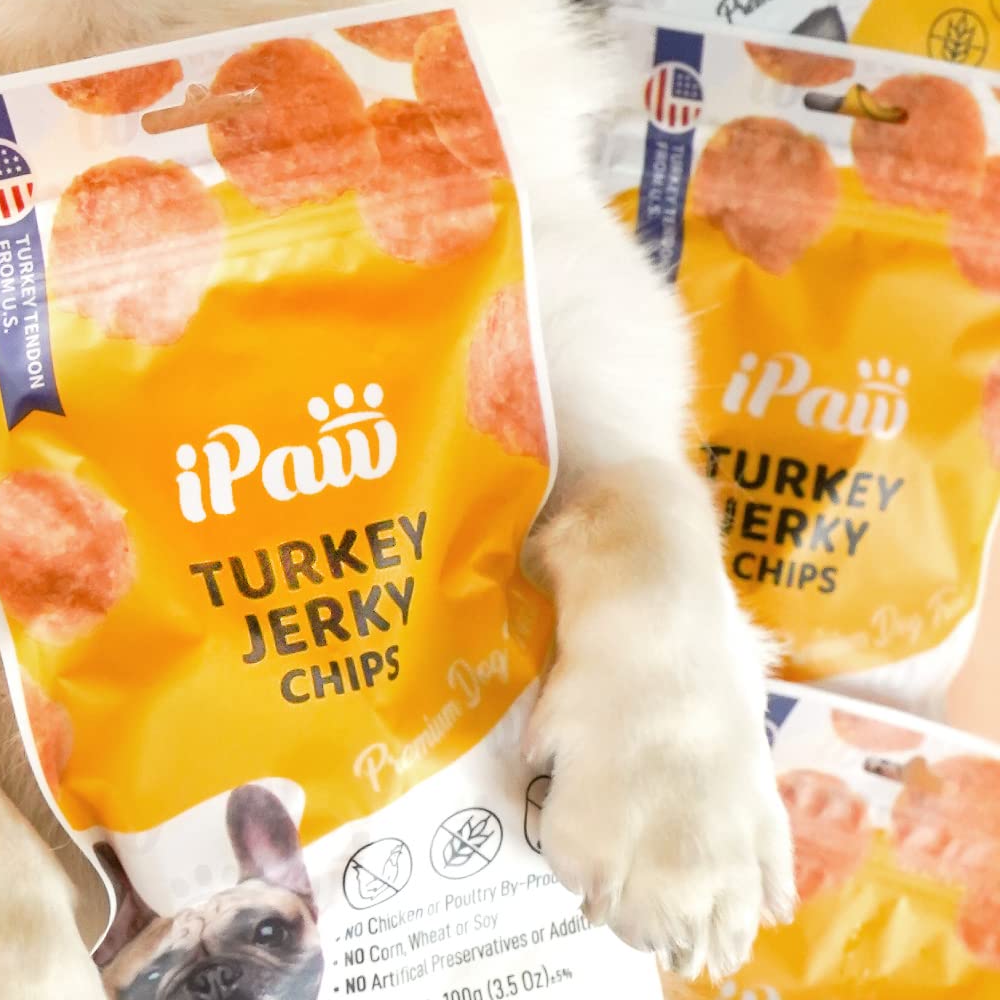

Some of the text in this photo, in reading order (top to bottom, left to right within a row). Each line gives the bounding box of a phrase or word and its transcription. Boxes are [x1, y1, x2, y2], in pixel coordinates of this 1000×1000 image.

[2, 299, 19, 334] U.S.
[15, 233, 45, 390] TURKEY TENDON
[721, 351, 910, 441] iPaw
[176, 383, 398, 523] iPaw
[701, 445, 905, 512] TURKEY
[189, 511, 428, 608] TURKEY
[732, 552, 838, 594] CHIPS
[242, 576, 416, 665] JERKY
[280, 645, 400, 705] CHIPS
[353, 647, 511, 793] Premium Dog
[345, 874, 559, 941] NO Chicken or Poultry By-Pro
[345, 913, 498, 967] NO Corn, Wheat or Soy
[346, 975, 366, 995] NO
[431, 932, 528, 973] Preservatives
[531, 927, 545, 945] or
[550, 914, 592, 941] Addit
